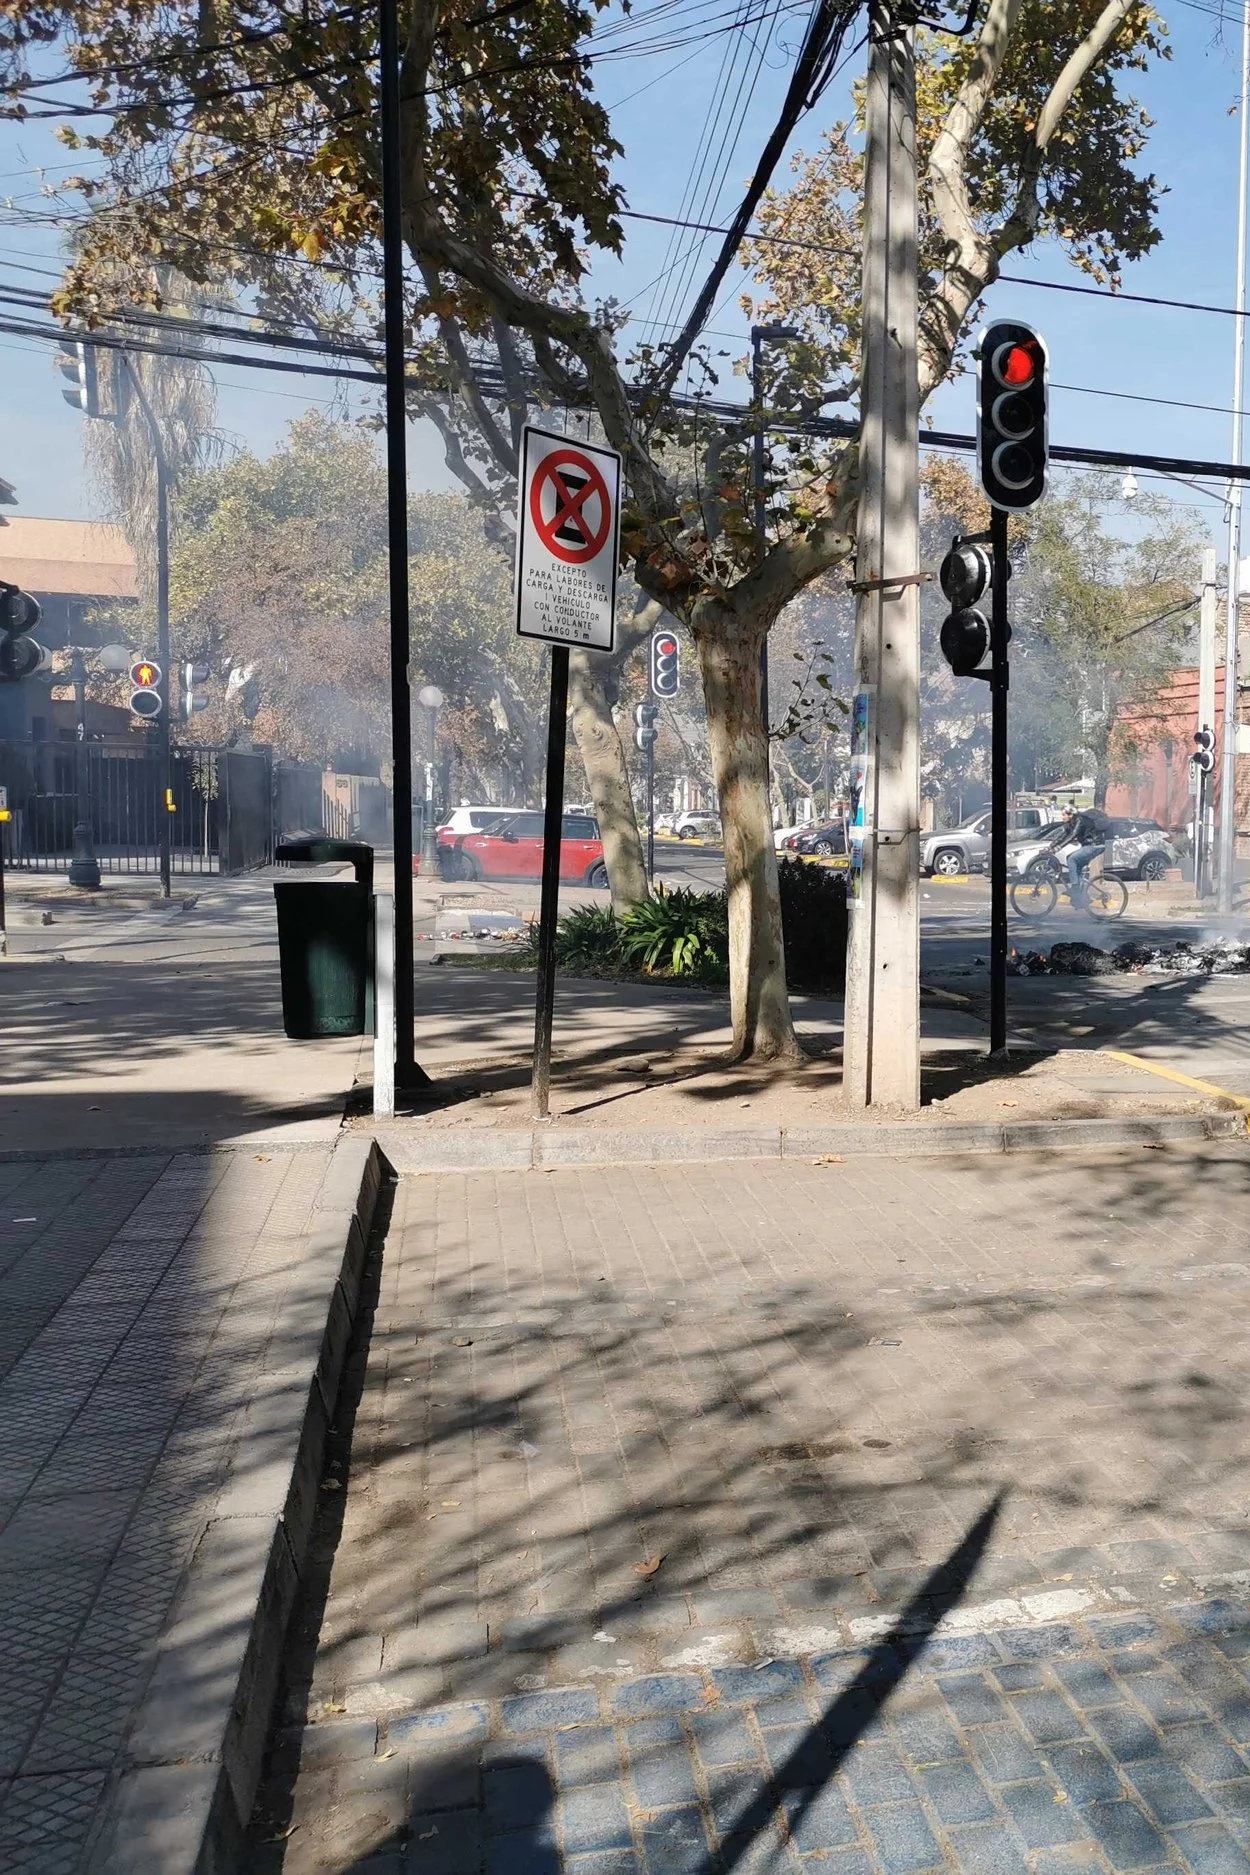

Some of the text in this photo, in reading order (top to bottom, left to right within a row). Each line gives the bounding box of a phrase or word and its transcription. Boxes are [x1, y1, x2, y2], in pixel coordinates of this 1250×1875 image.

[551, 563, 587, 578] EXCEPTO
[529, 568, 606, 593] PARA LABORES DE
[526, 578, 609, 603] CARGA Y DESCARGA
[534, 601, 550, 612] CON
[552, 594, 591, 609] VEHICULO
[541, 613, 592, 630] AL VOLANTE
[543, 624, 570, 636] LARGO
[574, 629, 579, 638] 5
